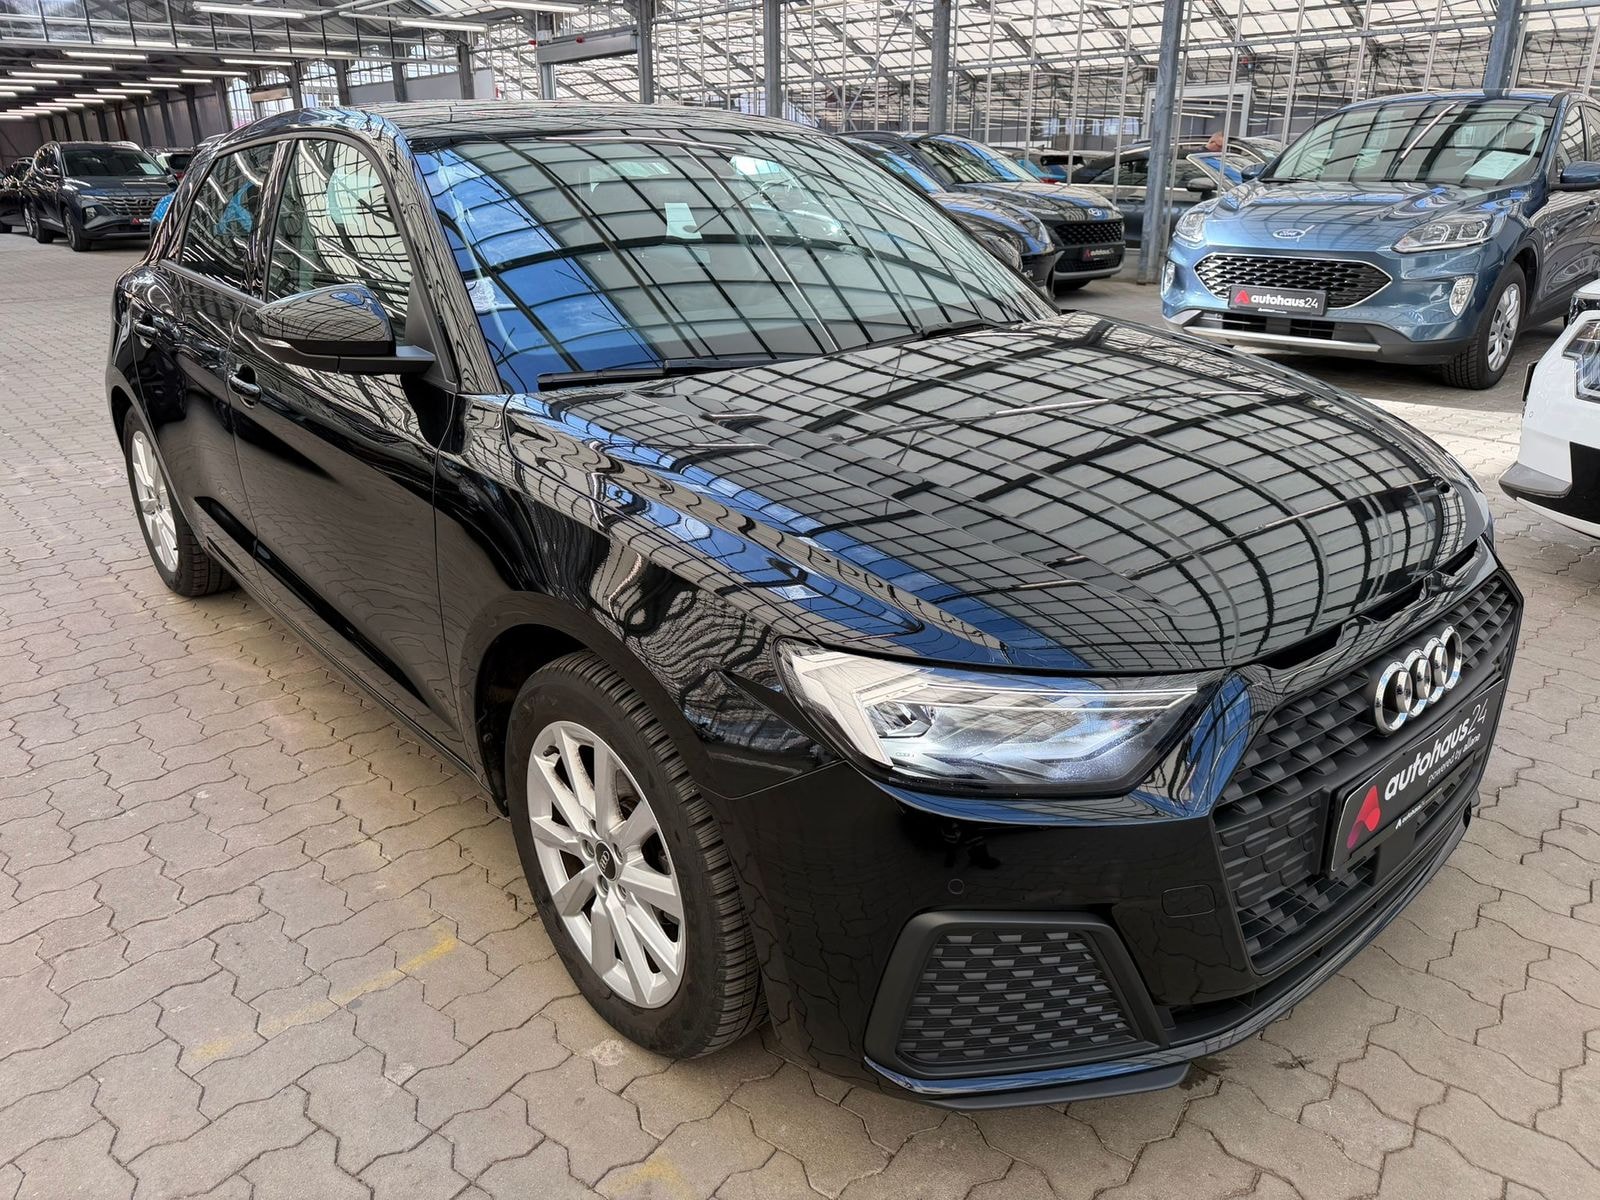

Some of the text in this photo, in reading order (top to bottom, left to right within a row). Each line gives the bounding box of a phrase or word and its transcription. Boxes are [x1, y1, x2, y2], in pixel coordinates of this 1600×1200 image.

[1250, 293, 1319, 309] autohaus24
[1384, 697, 1489, 801] autohaus24
[1427, 751, 1455, 787] powered
